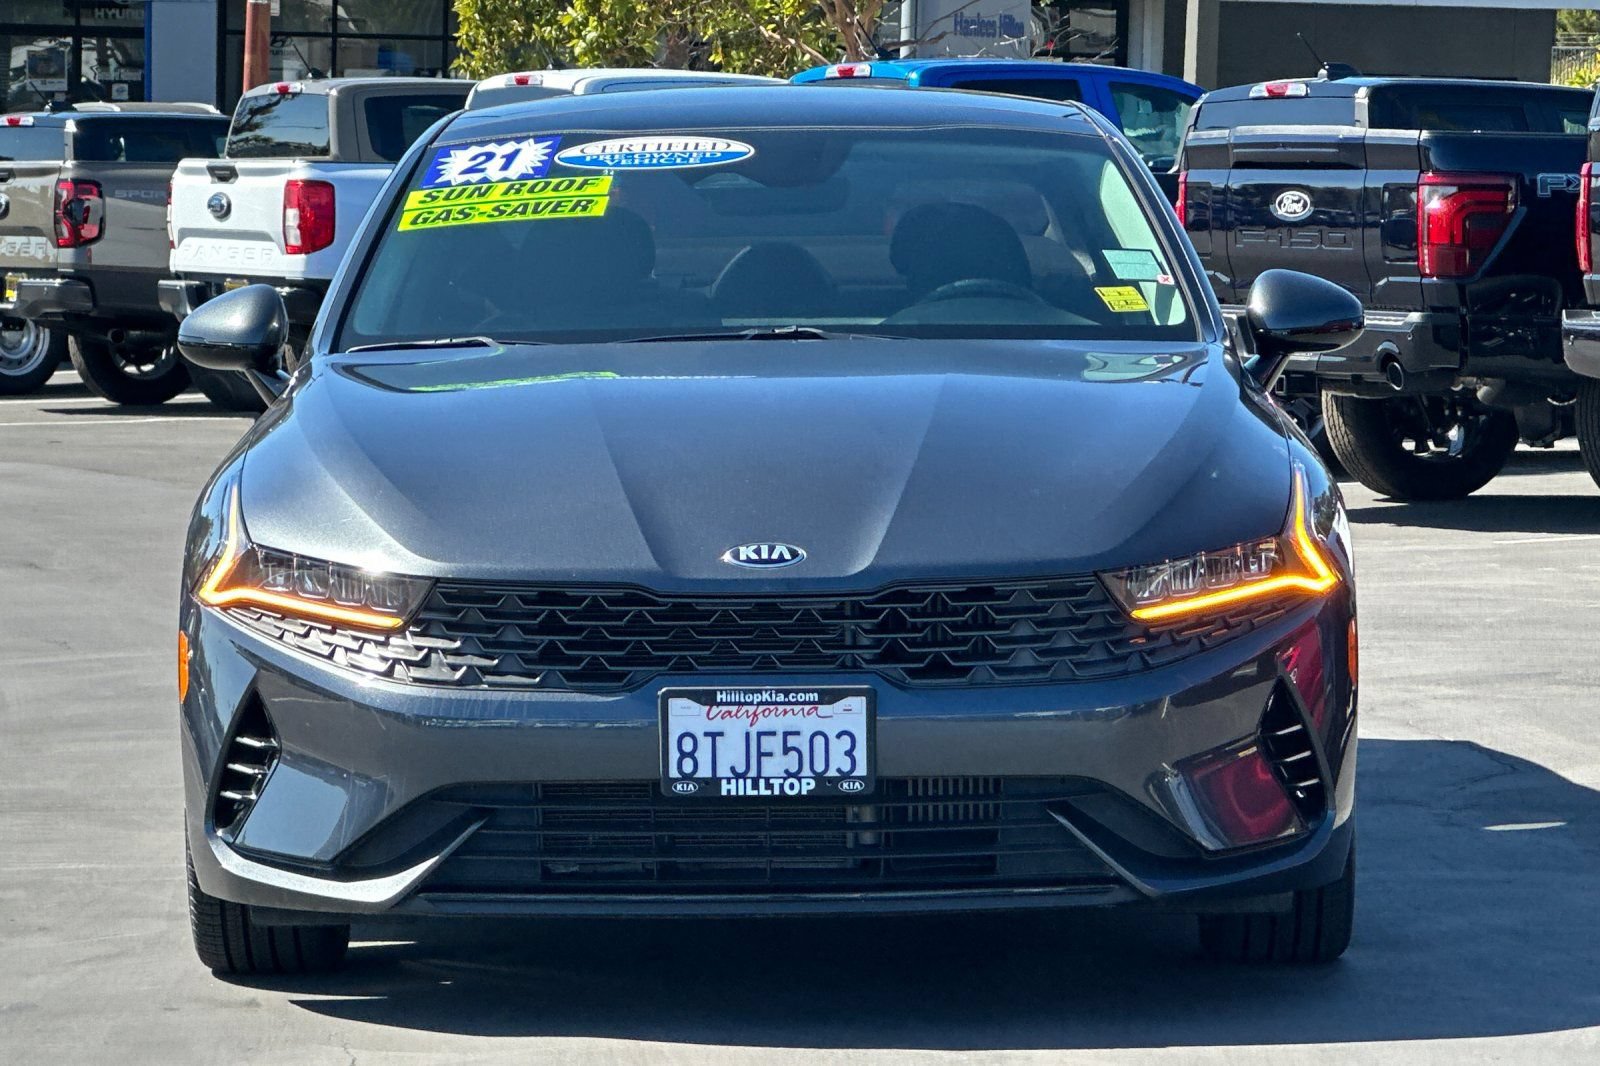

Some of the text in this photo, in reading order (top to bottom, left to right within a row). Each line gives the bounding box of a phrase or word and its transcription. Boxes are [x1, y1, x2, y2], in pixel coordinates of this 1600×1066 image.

[580, 142, 732, 154] CERTIFIED
[458, 148, 523, 176] 21
[604, 157, 701, 166] VEHICLE
[418, 177, 602, 204] SUN ROOF
[409, 198, 599, 227] GAS-SAVER
[738, 544, 792, 561] KIA
[716, 690, 819, 705] HilltopKia.com
[706, 704, 834, 728] California
[676, 730, 857, 777] 8TJF503
[720, 777, 816, 796] HILLTOP
